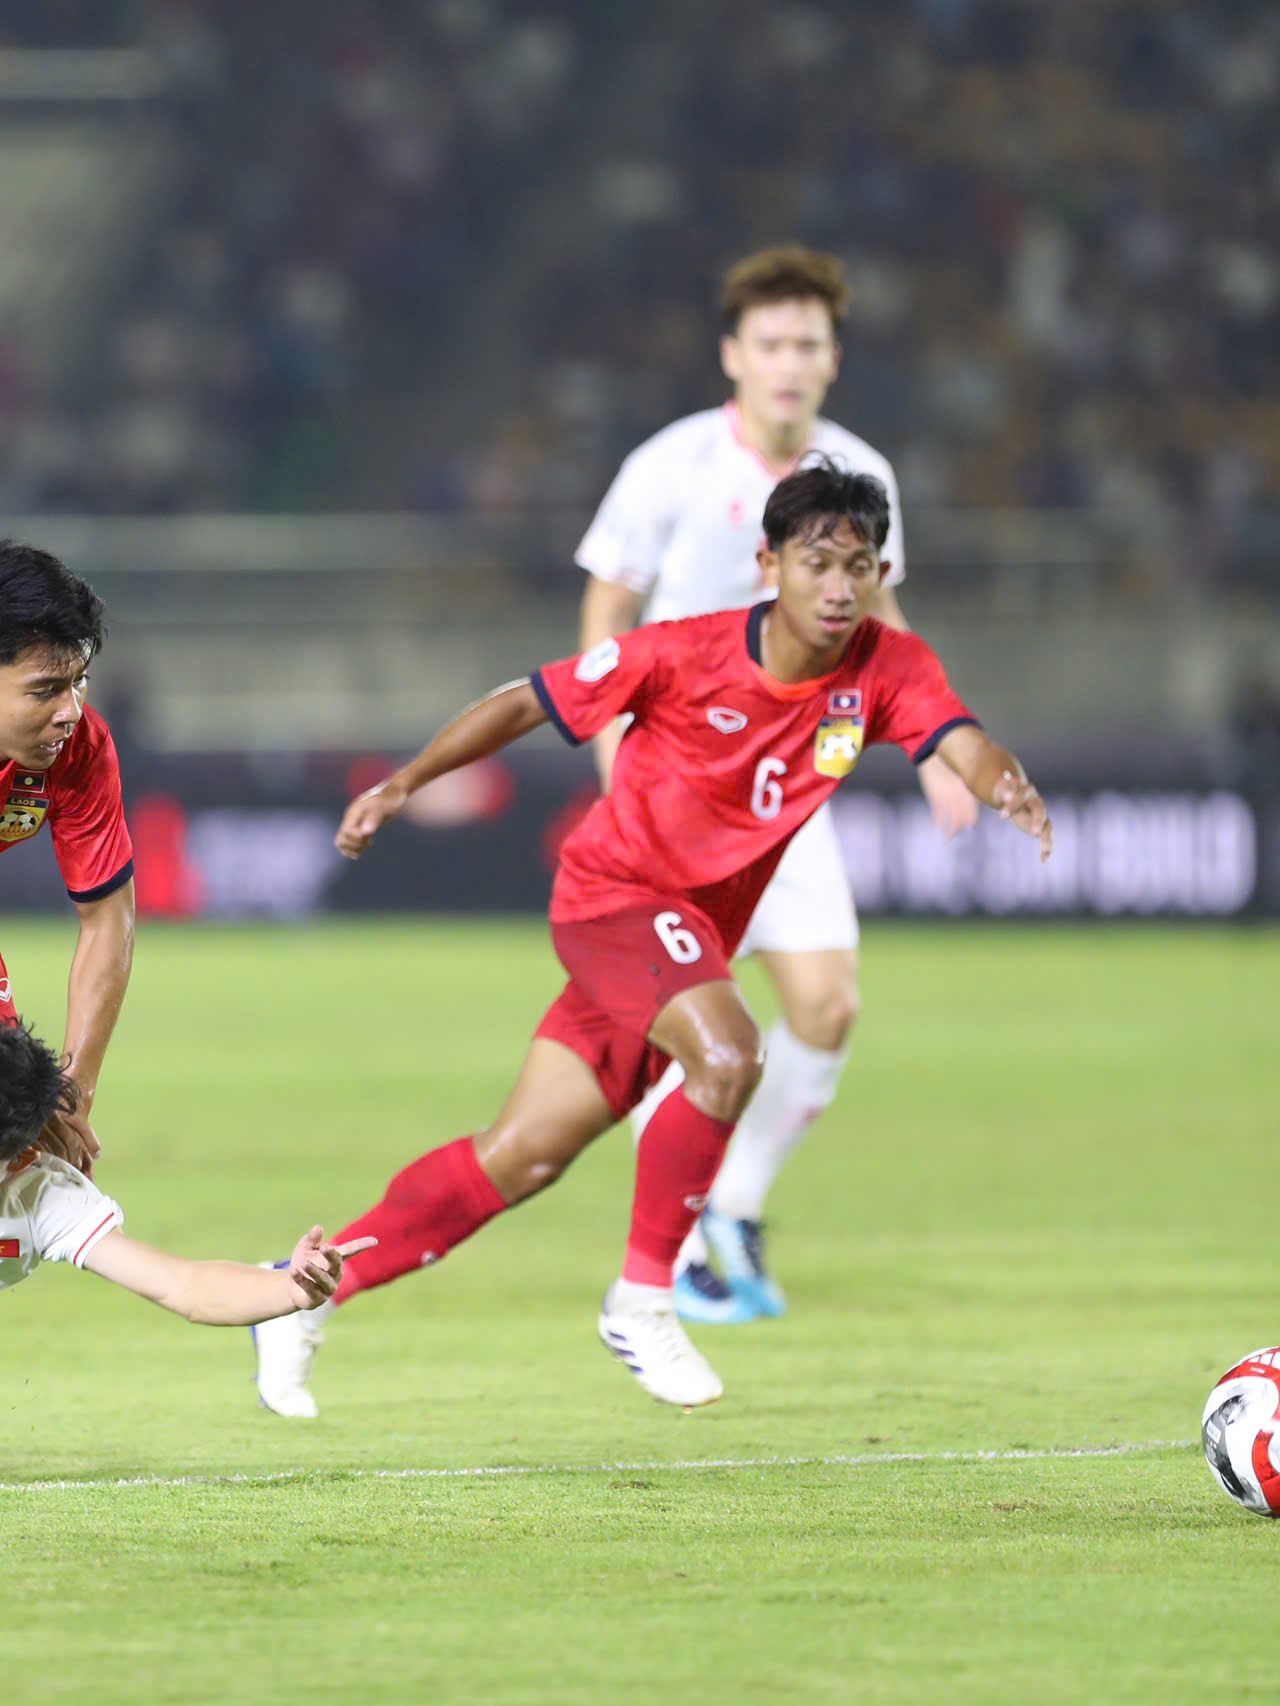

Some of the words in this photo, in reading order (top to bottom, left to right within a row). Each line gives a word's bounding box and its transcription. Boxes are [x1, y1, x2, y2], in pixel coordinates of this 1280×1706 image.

[10, 797, 36, 807] LAOS
[750, 756, 788, 820] 6
[653, 911, 703, 965] 6
